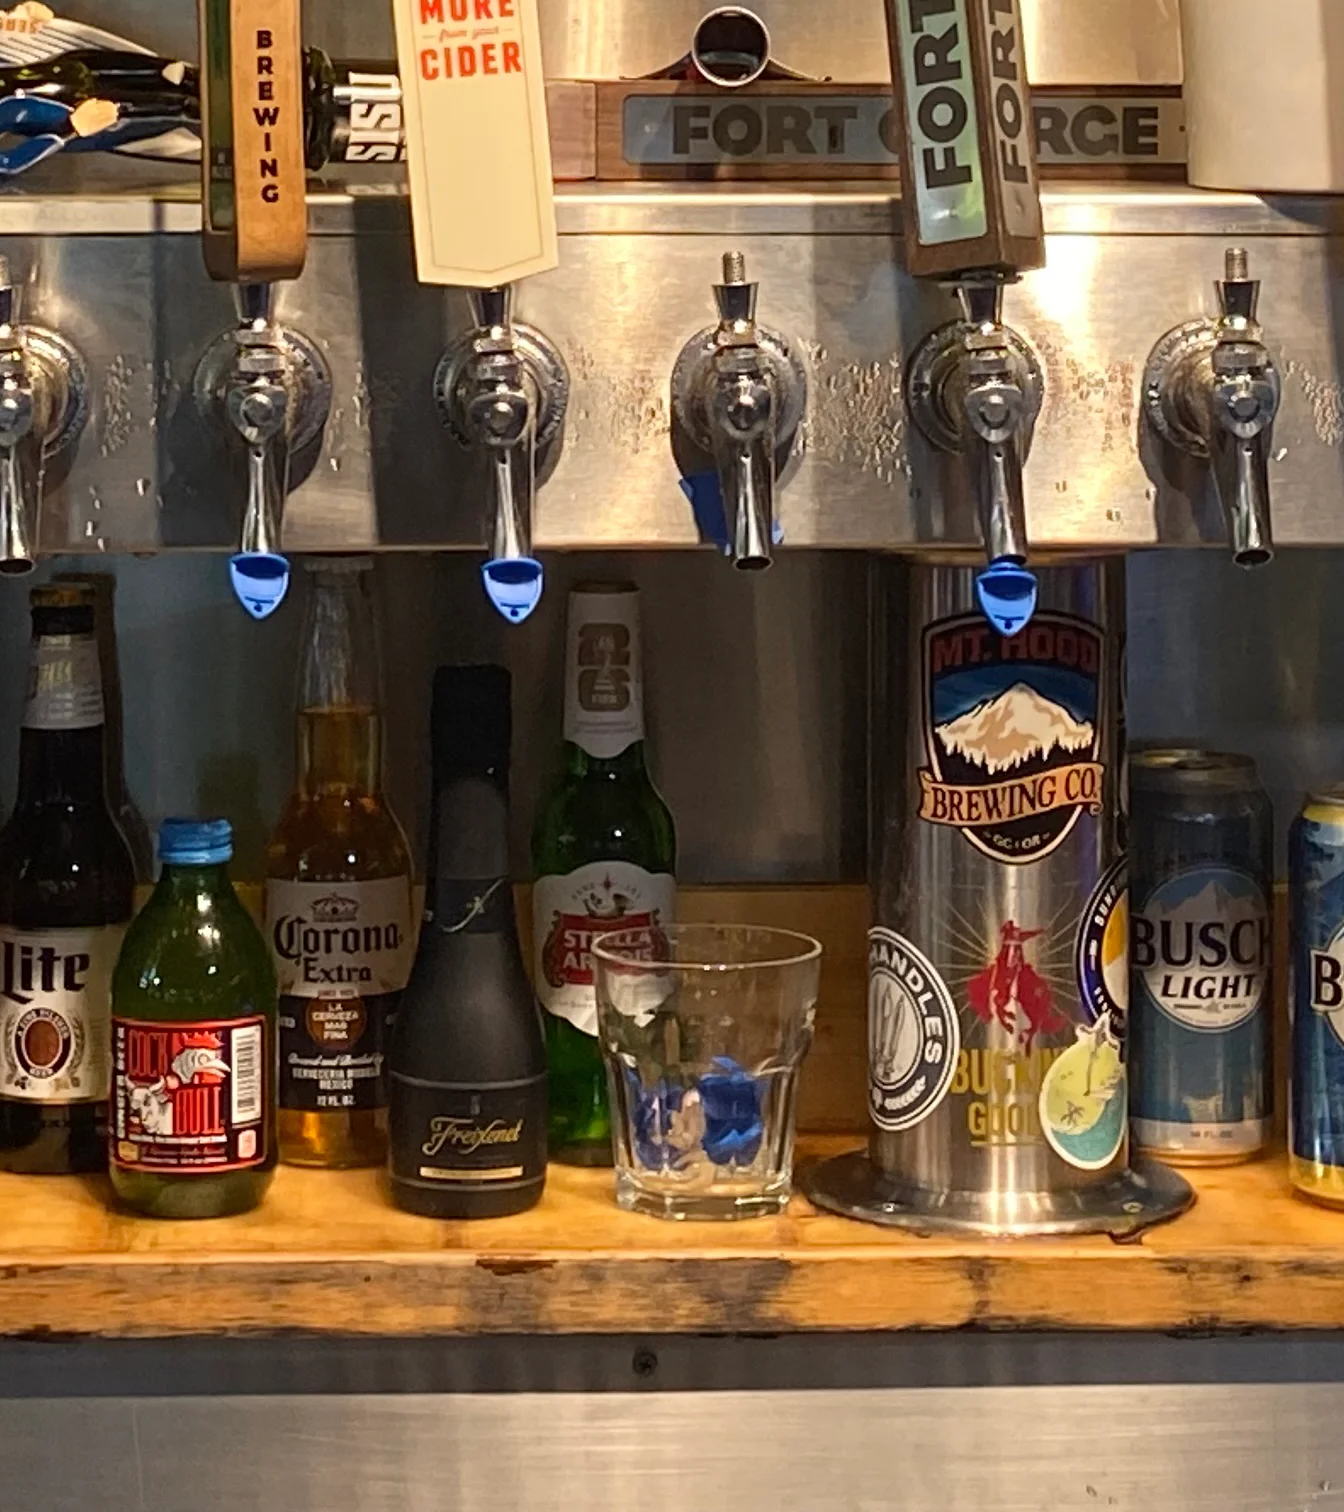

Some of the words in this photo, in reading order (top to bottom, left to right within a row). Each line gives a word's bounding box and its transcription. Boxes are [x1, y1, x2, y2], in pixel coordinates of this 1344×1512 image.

[420, 40, 522, 81] CIDER
[253, 28, 281, 205] BREWING
[671, 103, 859, 157] FORT
[933, 629, 992, 673] MT.
[1000, 627, 1098, 670] HOOD
[930, 774, 1057, 823] BREWING
[1064, 766, 1098, 800] CO.
[1021, 834, 1042, 849] OR
[273, 915, 401, 967] Corona
[0, 940, 91, 1005] Lite
[303, 957, 373, 984] Extra
[1160, 974, 1258, 1000] LIGHT
[127, 1029, 169, 1079] COCK
[175, 1086, 225, 1135] BULL
